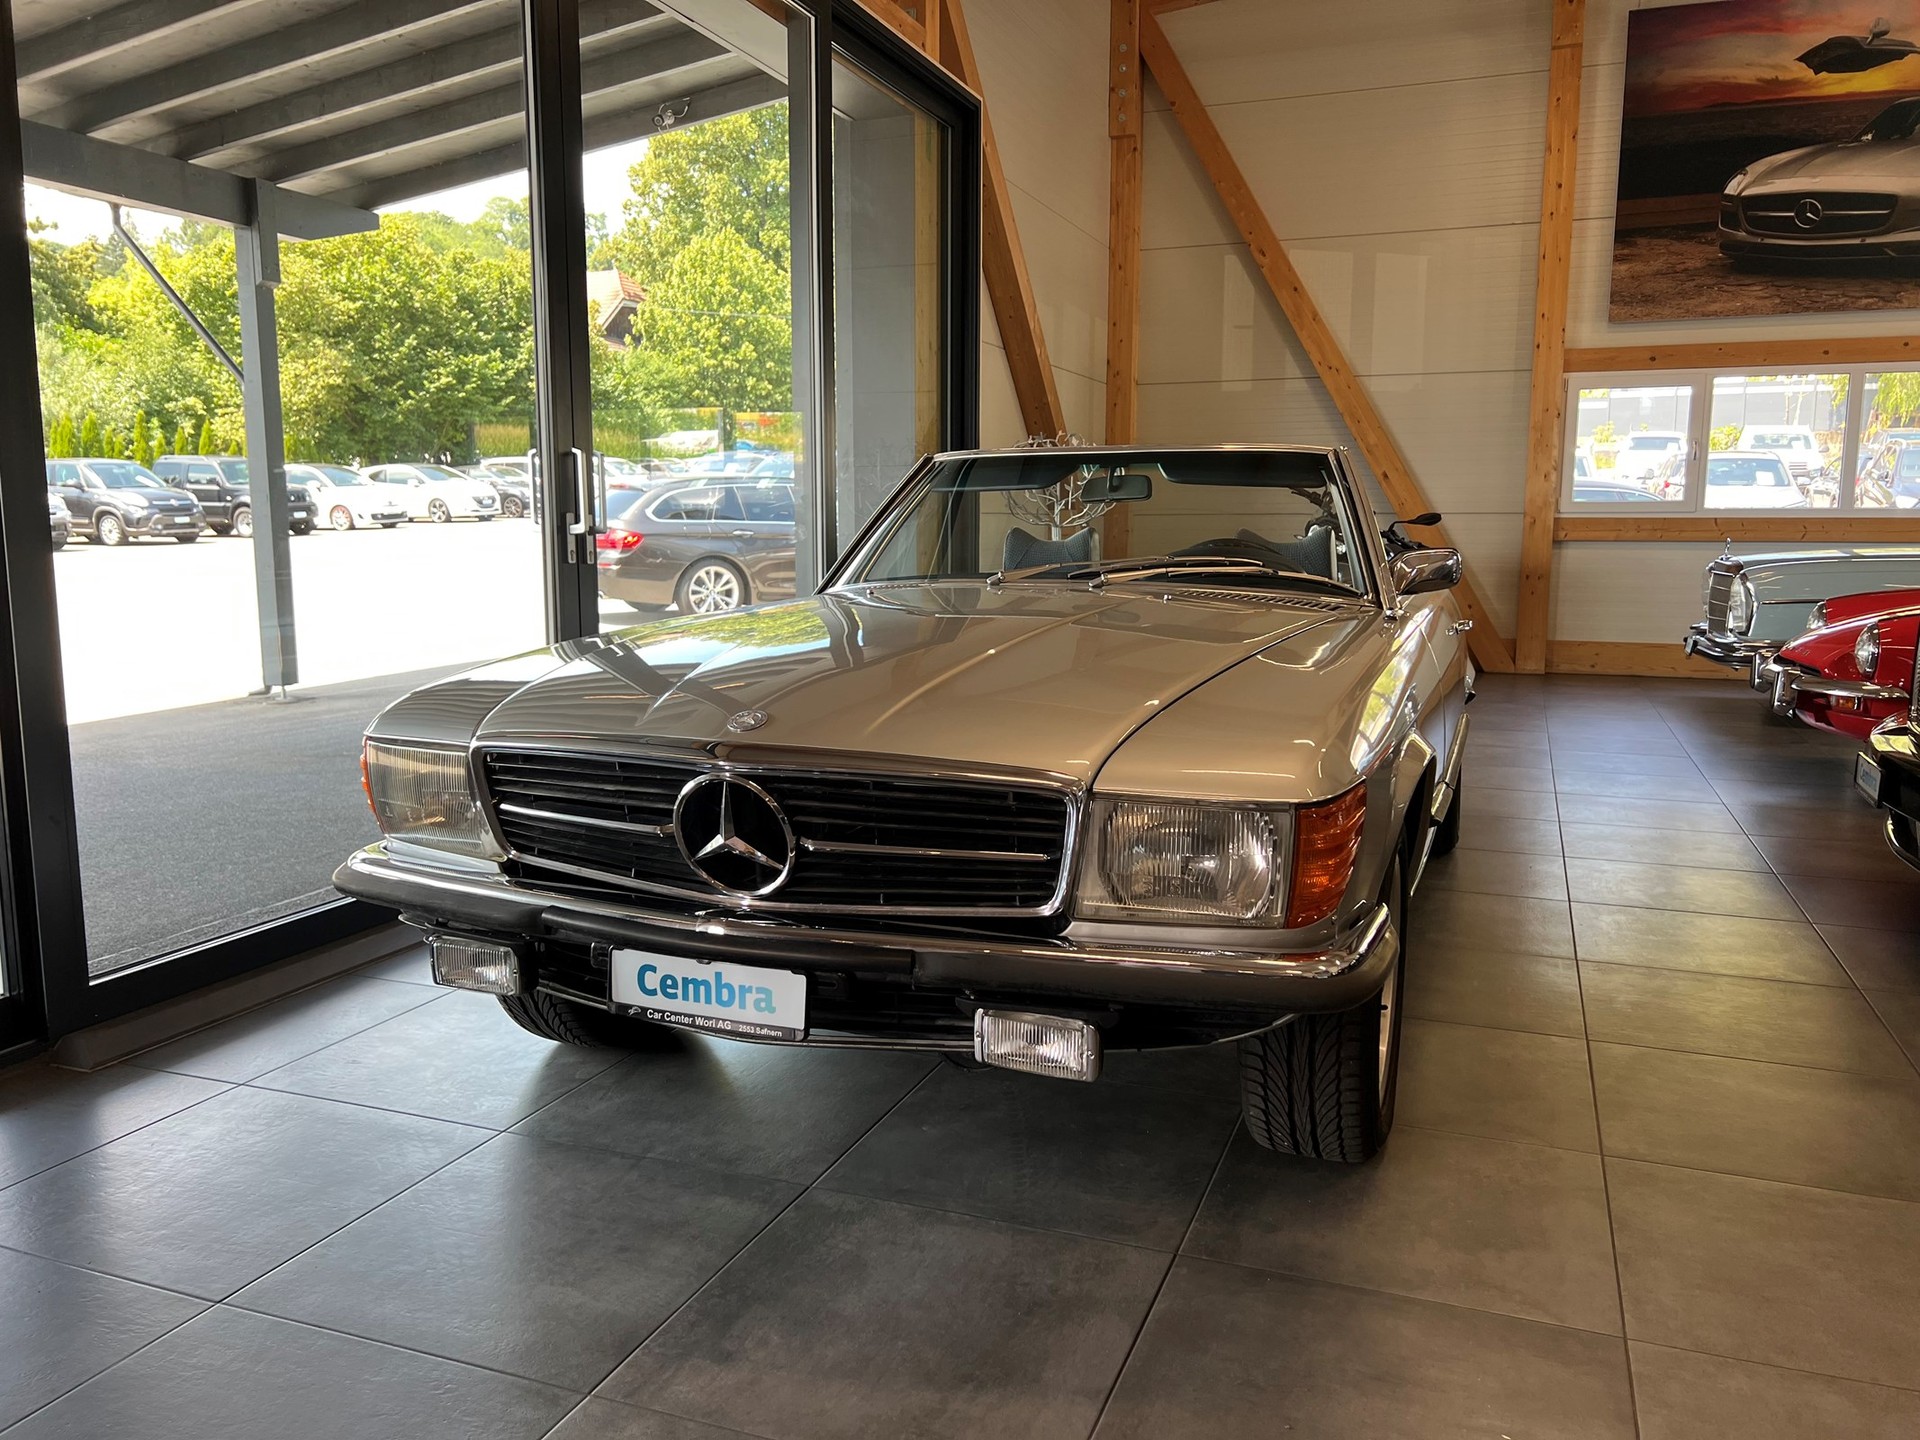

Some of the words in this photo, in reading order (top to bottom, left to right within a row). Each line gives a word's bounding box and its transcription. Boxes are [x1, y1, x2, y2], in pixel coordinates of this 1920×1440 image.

[637, 964, 776, 1014] Cembra
[646, 1009, 663, 1020] Car
[664, 1011, 694, 1025] Center
[717, 1019, 732, 1030] AG
[738, 1024, 755, 1034] 2553
[756, 1026, 782, 1037] Safnern
